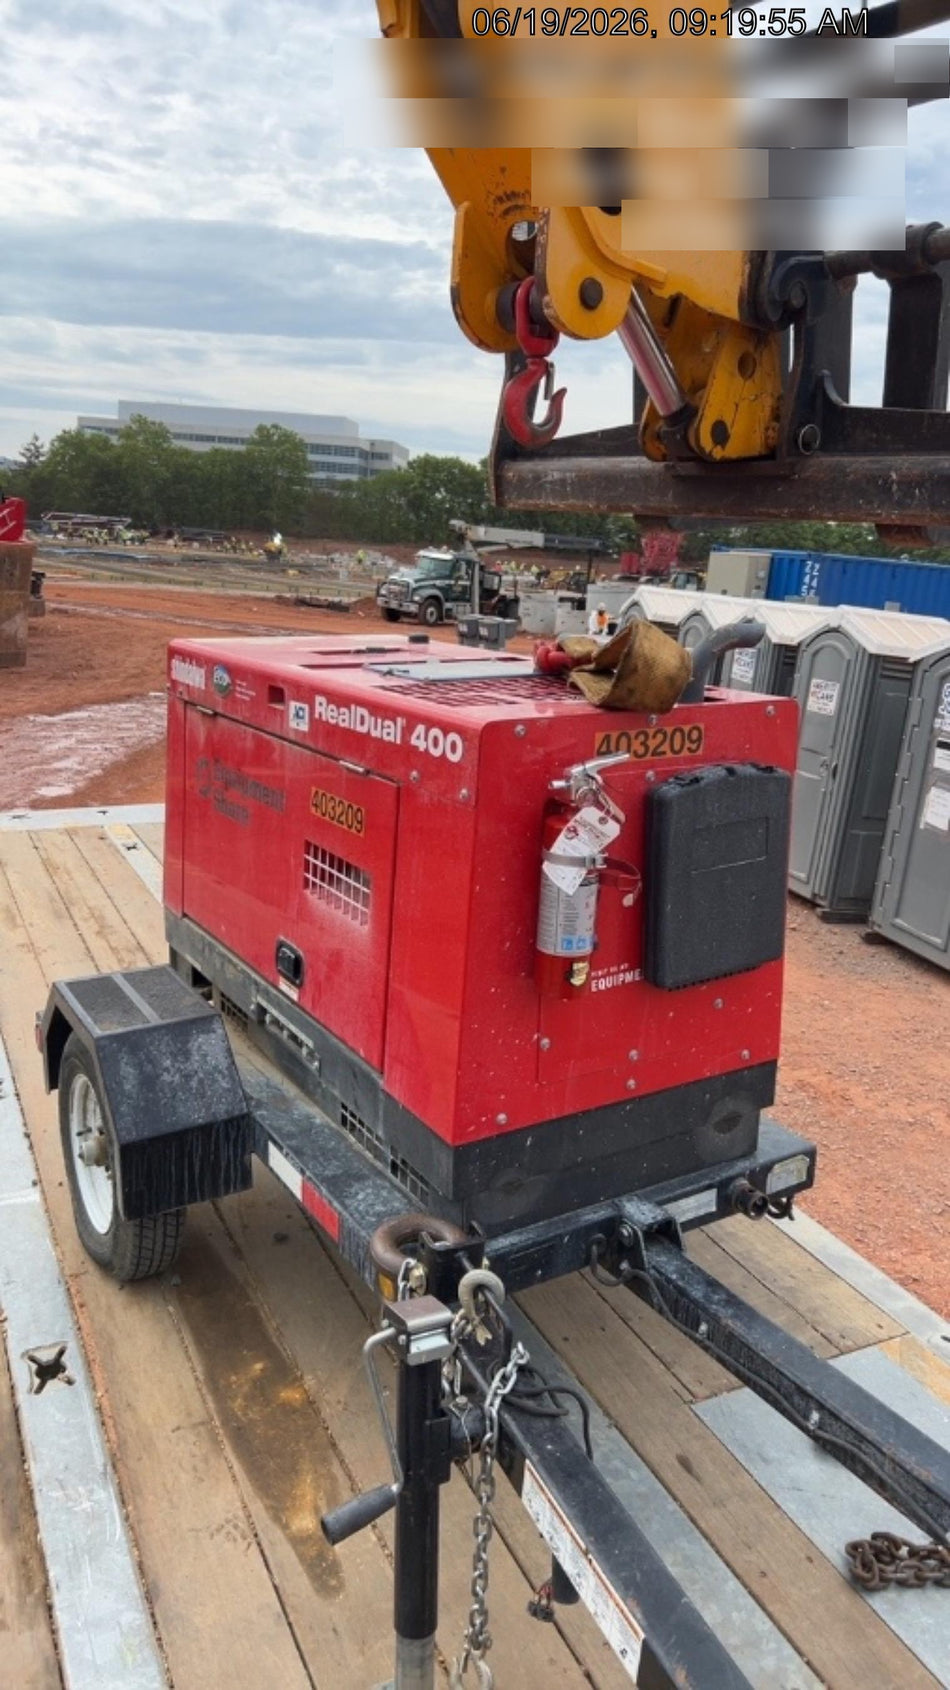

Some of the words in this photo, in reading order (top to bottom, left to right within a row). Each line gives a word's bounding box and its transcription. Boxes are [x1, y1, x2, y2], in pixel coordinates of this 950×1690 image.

[314, 694, 402, 745] RealDual
[410, 723, 464, 764] 400
[596, 724, 703, 760] 403209
[311, 788, 364, 835] 403209
[590, 968, 644, 993] EQUIPME
